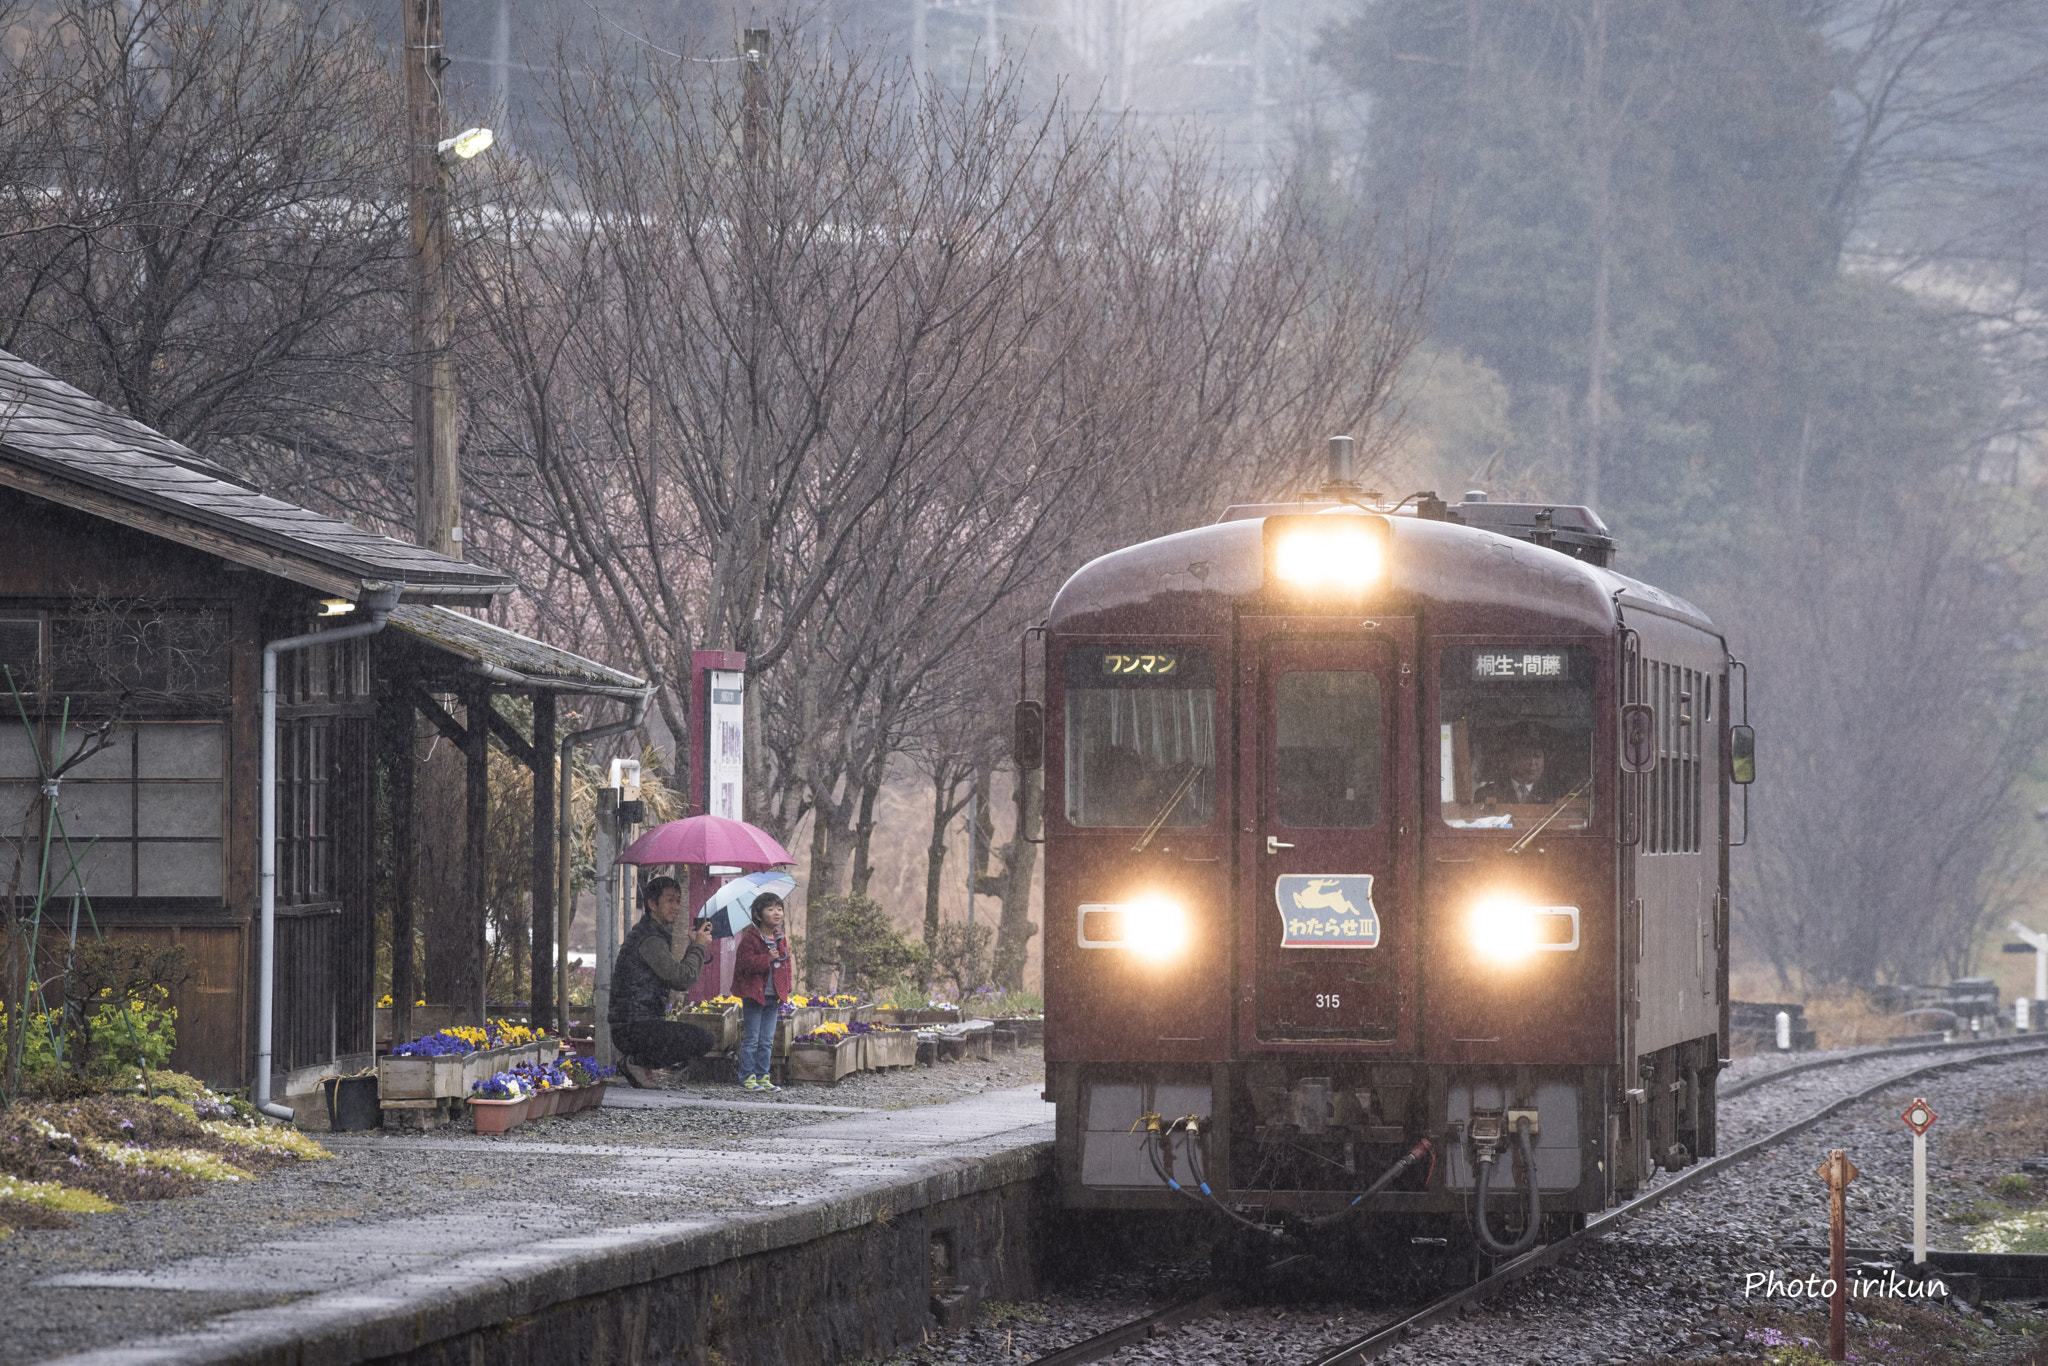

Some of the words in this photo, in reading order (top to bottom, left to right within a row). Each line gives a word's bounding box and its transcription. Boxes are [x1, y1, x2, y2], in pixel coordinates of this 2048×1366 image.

[1105, 655, 1176, 673] ワンマン
[1315, 993, 1341, 1008] 315
